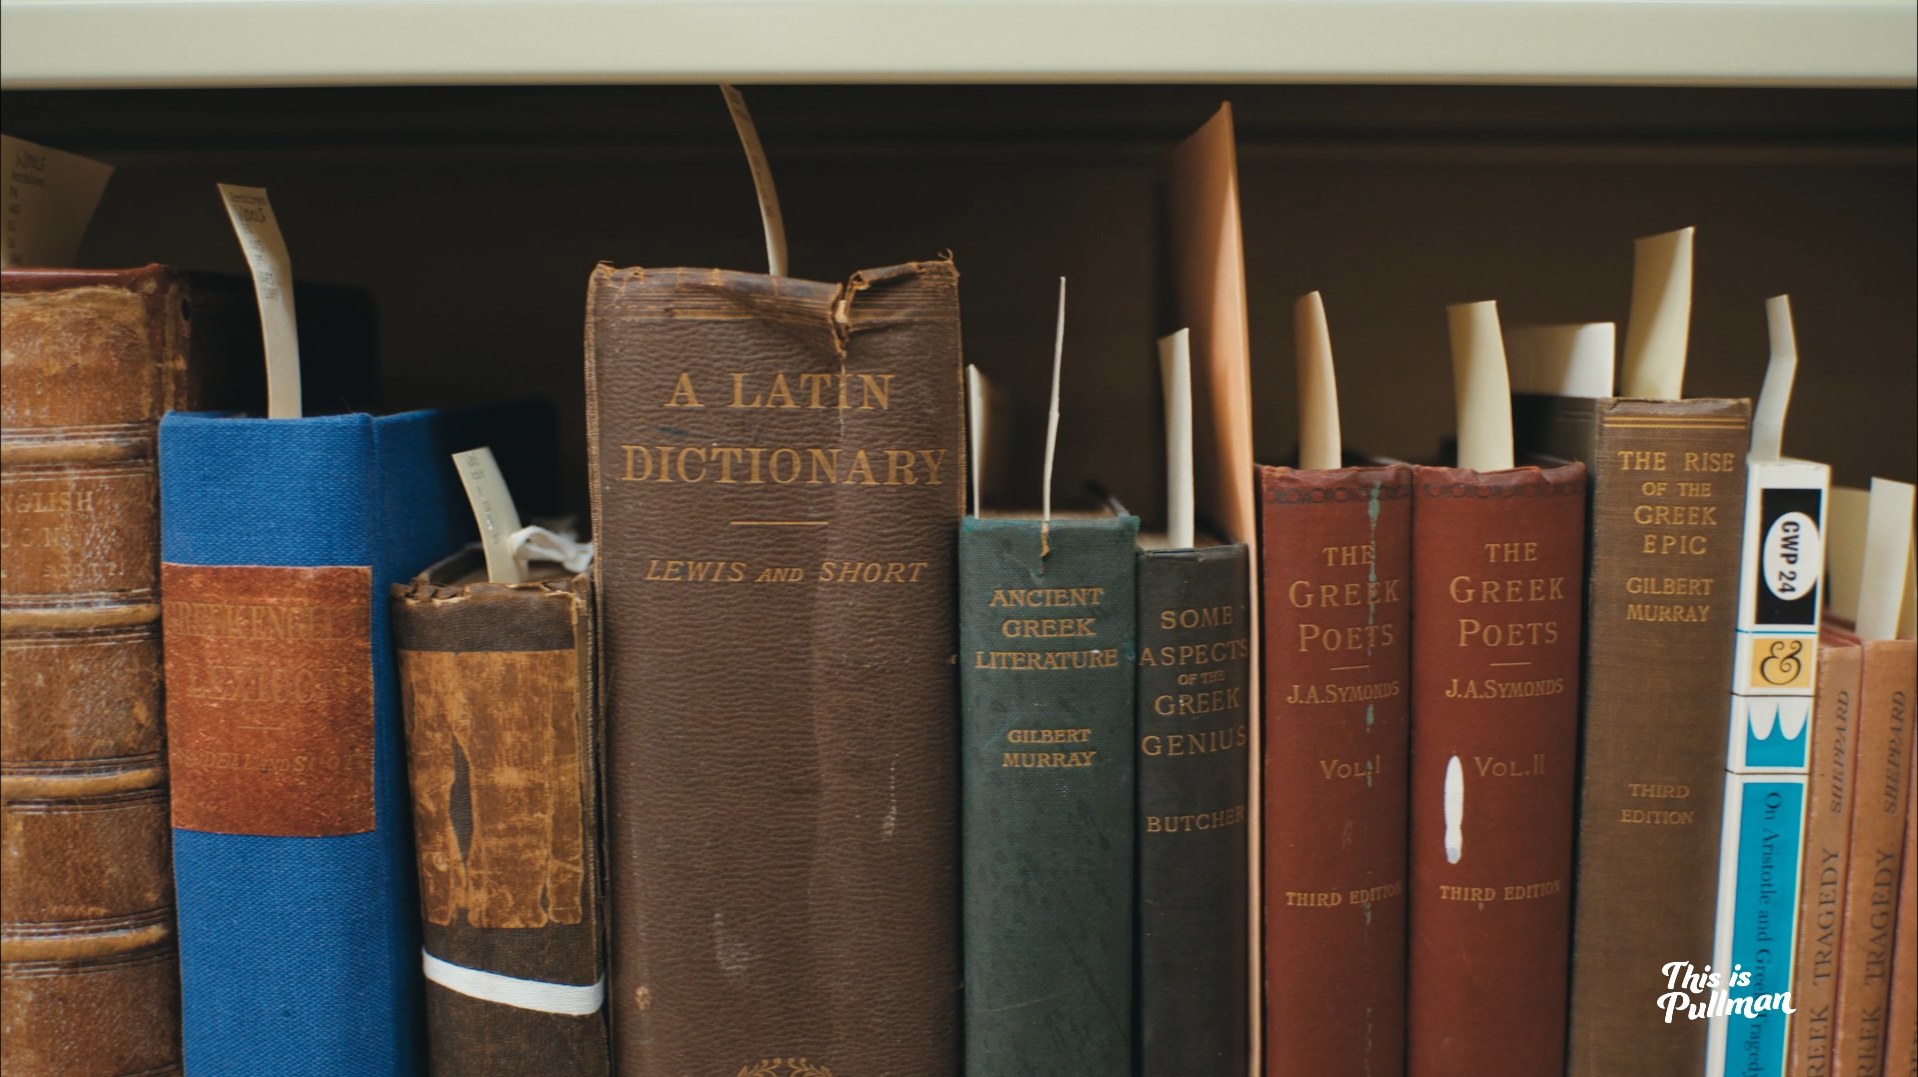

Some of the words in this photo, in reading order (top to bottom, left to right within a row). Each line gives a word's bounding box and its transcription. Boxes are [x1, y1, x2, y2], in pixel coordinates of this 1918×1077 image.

[664, 371, 705, 408] A
[726, 372, 896, 411] LATIN
[621, 445, 948, 486] DICTIONARY
[1617, 450, 1668, 472] THE
[1683, 452, 1735, 473] RISE
[1641, 482, 1668, 498] OF
[1677, 482, 1713, 498] THE
[1633, 505, 1718, 526] GREEK
[1486, 542, 1538, 563] THE
[1643, 535, 1707, 555] EPIC
[1778, 520, 1801, 566] CWP
[1321, 545, 1374, 567] THE
[643, 560, 748, 583] LEWIS
[754, 567, 806, 583] AND
[816, 561, 929, 584] SHORT
[1777, 570, 1798, 594] 24
[988, 587, 1105, 608] ANCIENT
[1448, 575, 1565, 604] GREEK
[1625, 577, 1715, 596] GILBERT
[1160, 605, 1234, 631] SOME
[1625, 604, 1711, 623] MURRAY
[1001, 618, 1097, 638] GREEK
[1457, 617, 1560, 648] POETS
[975, 648, 1120, 670] LITERATURE
[1138, 638, 1249, 667] ASPECTS
[1177, 674, 1198, 686] OF
[1200, 670, 1226, 685] THE
[1153, 686, 1241, 716] GREEK
[1006, 729, 1092, 744] GILBERT
[1140, 725, 1248, 757] GENIUS
[1001, 750, 1098, 768] MURRAY
[1830, 690, 1850, 814] SHEPPARD
[1884, 690, 1906, 815] SHEPPARD
[1627, 783, 1691, 799] THIRD
[1619, 809, 1695, 826] EDITION
[1764, 792, 1782, 821] On
[1145, 805, 1247, 833] BUTCHER
[1758, 828, 1780, 905] Aristotle
[1285, 891, 1343, 908] THIRD
[1348, 880, 1402, 905] EDITION
[1438, 885, 1497, 902] THIRD
[1502, 879, 1562, 901] EDITION
[1756, 909, 1773, 942] and
[1813, 847, 1840, 987] TRAGEDY
[1865, 847, 1896, 987] TRAGEDY
